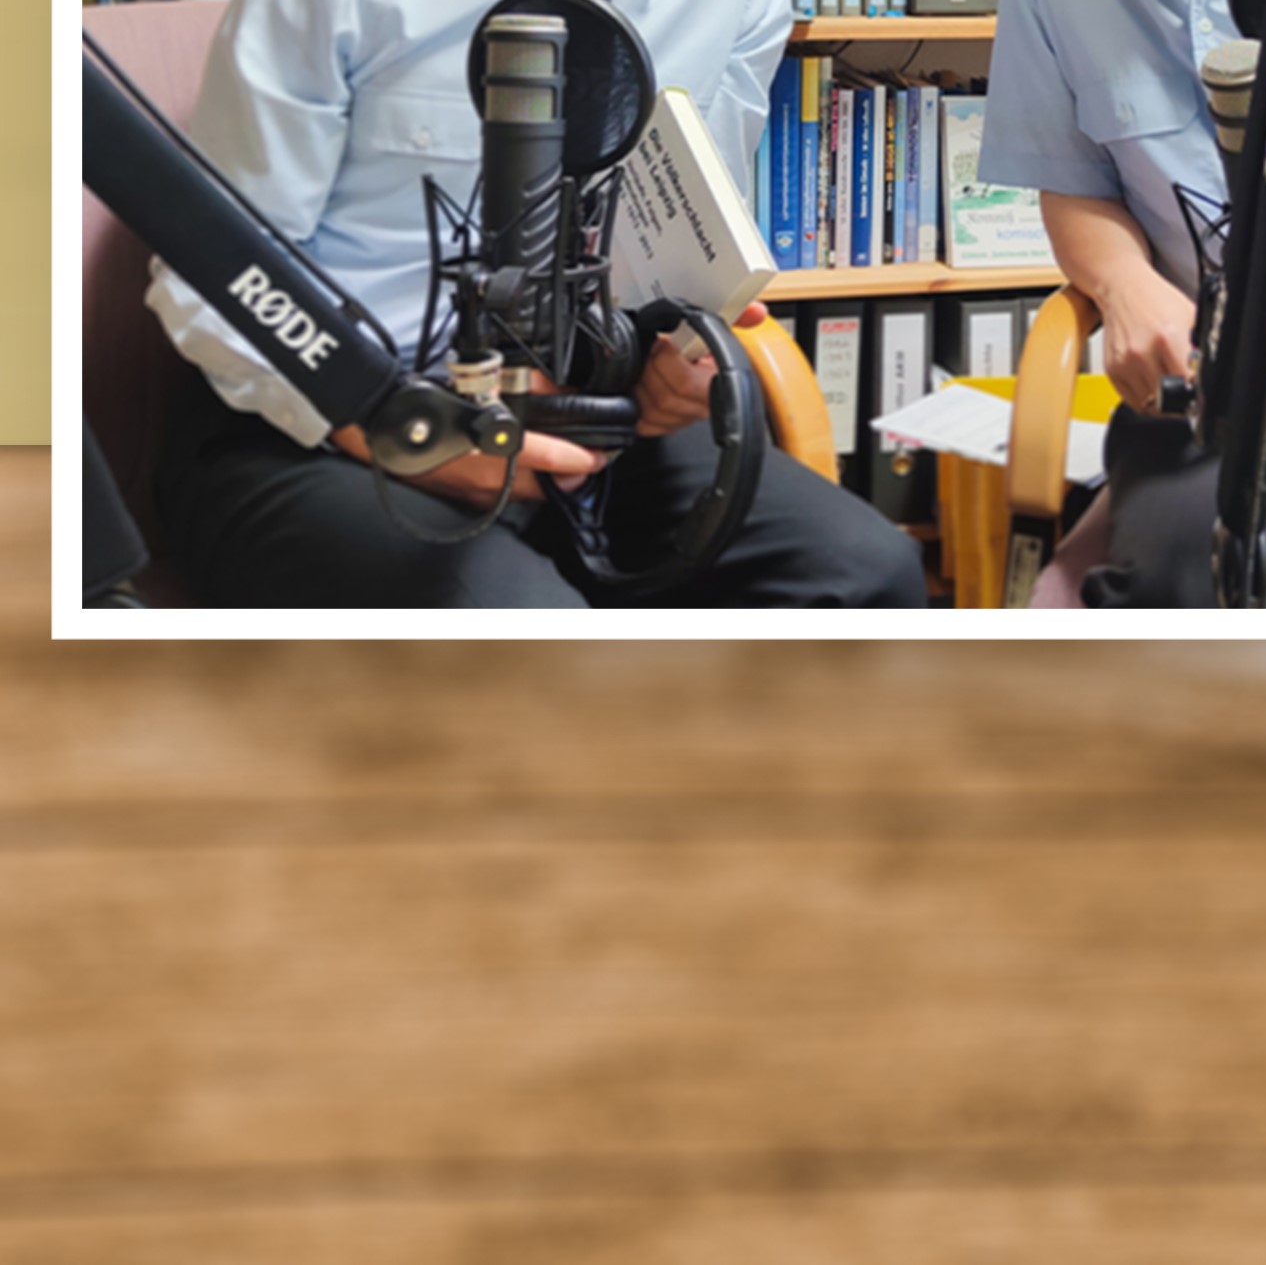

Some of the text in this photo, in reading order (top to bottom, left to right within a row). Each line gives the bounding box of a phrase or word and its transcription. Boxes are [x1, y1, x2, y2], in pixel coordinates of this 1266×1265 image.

[648, 127, 716, 264] Die Völkerschlacht
[649, 164, 677, 220] Leipzig
[228, 264, 340, 371] RØDE
